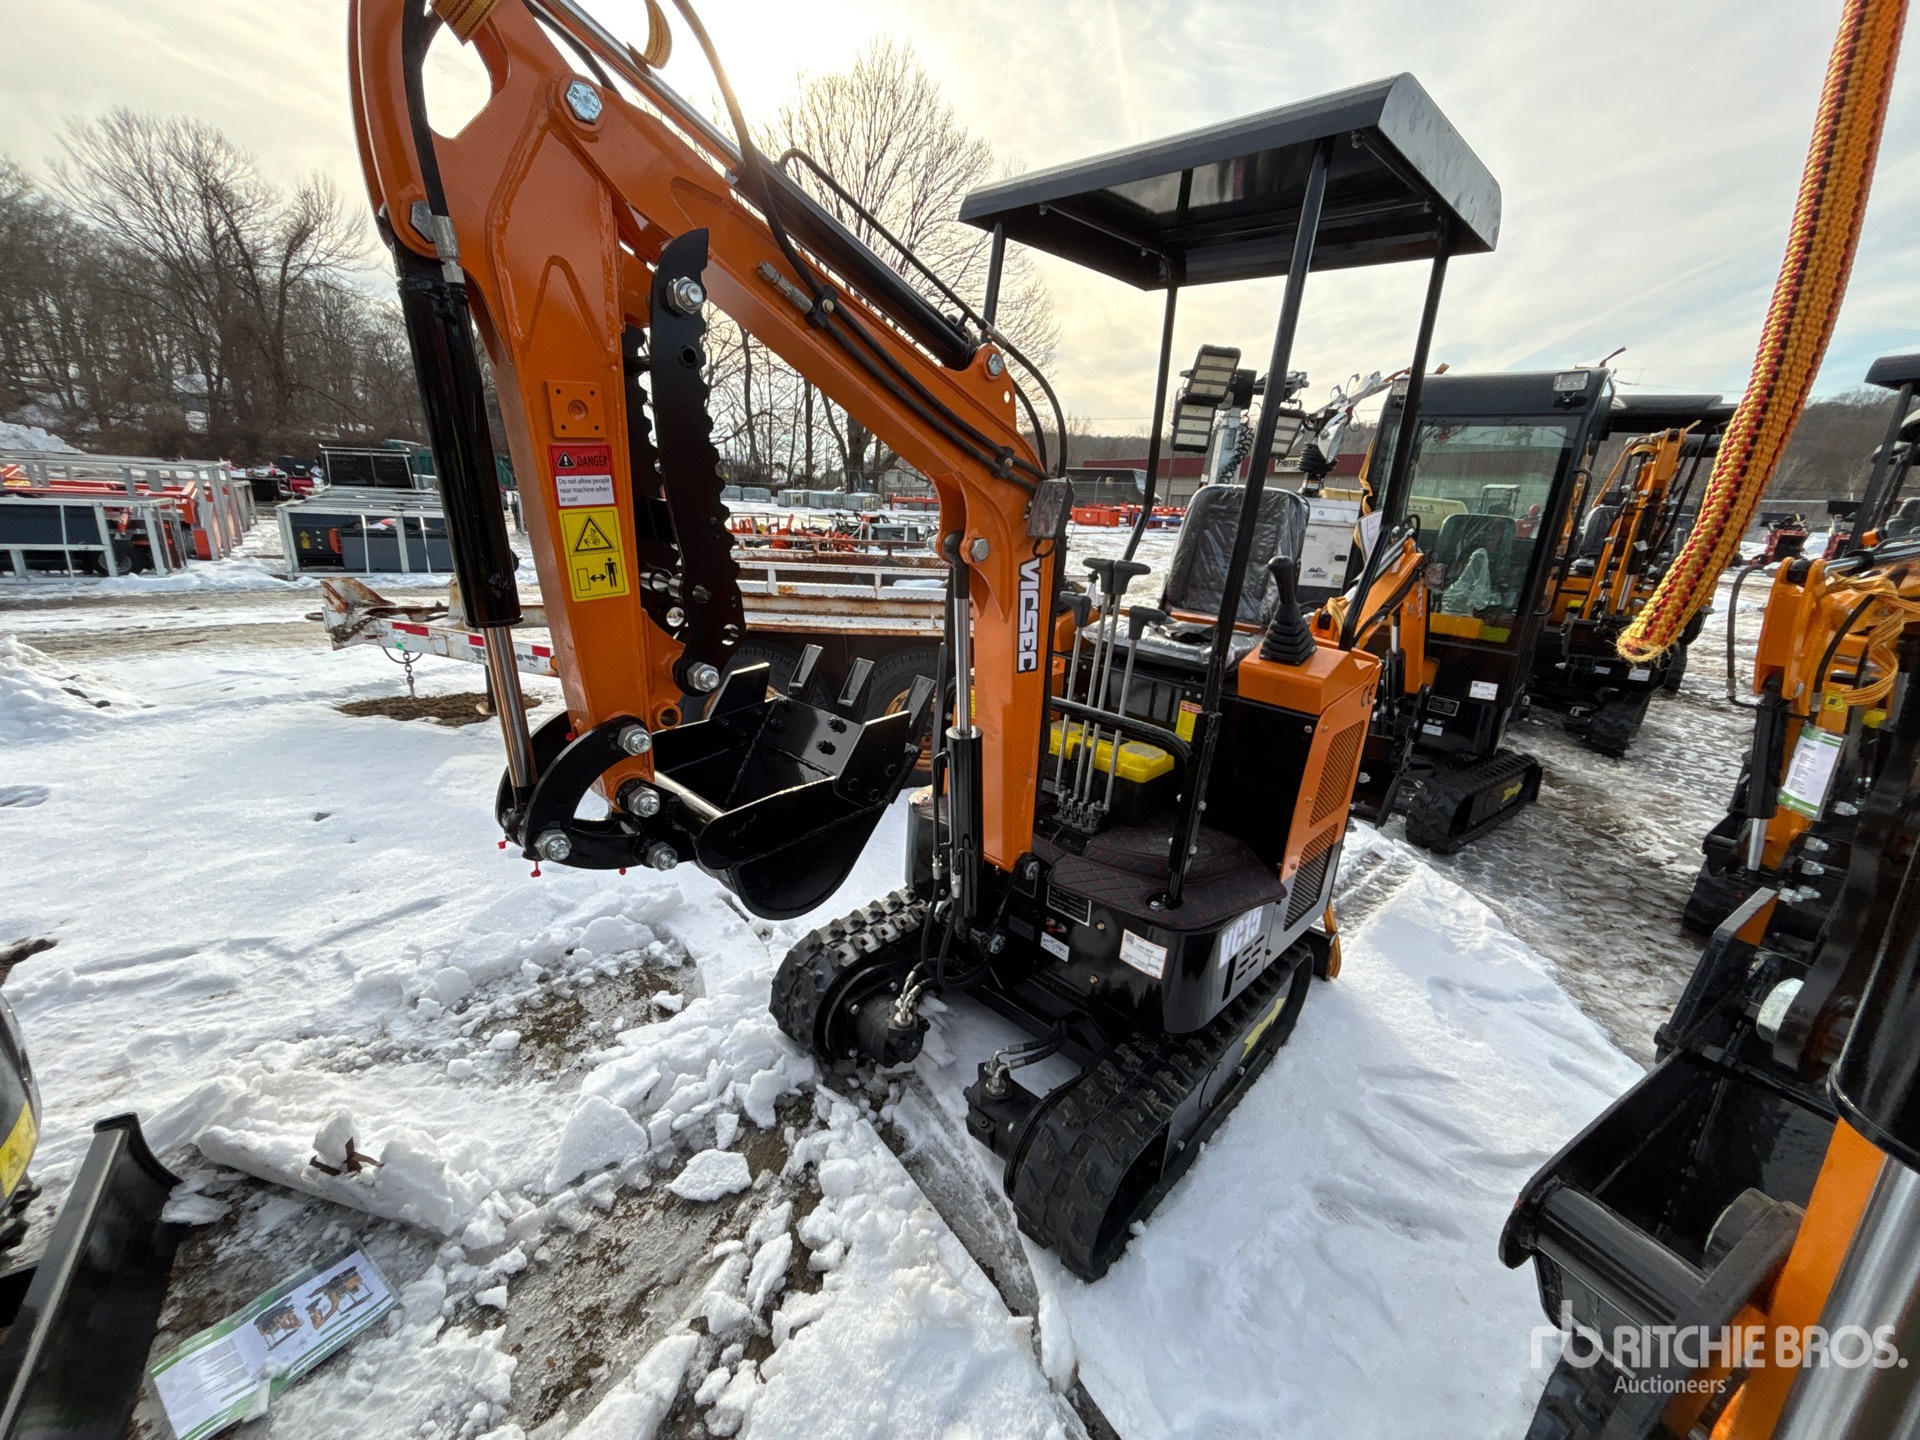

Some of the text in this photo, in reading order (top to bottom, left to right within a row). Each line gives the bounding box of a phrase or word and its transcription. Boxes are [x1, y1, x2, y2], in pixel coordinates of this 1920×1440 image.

[576, 455, 609, 467] DANGER
[592, 477, 610, 485] people
[1018, 557, 1040, 672] VICSEC
[1218, 906, 1264, 968] VC15
